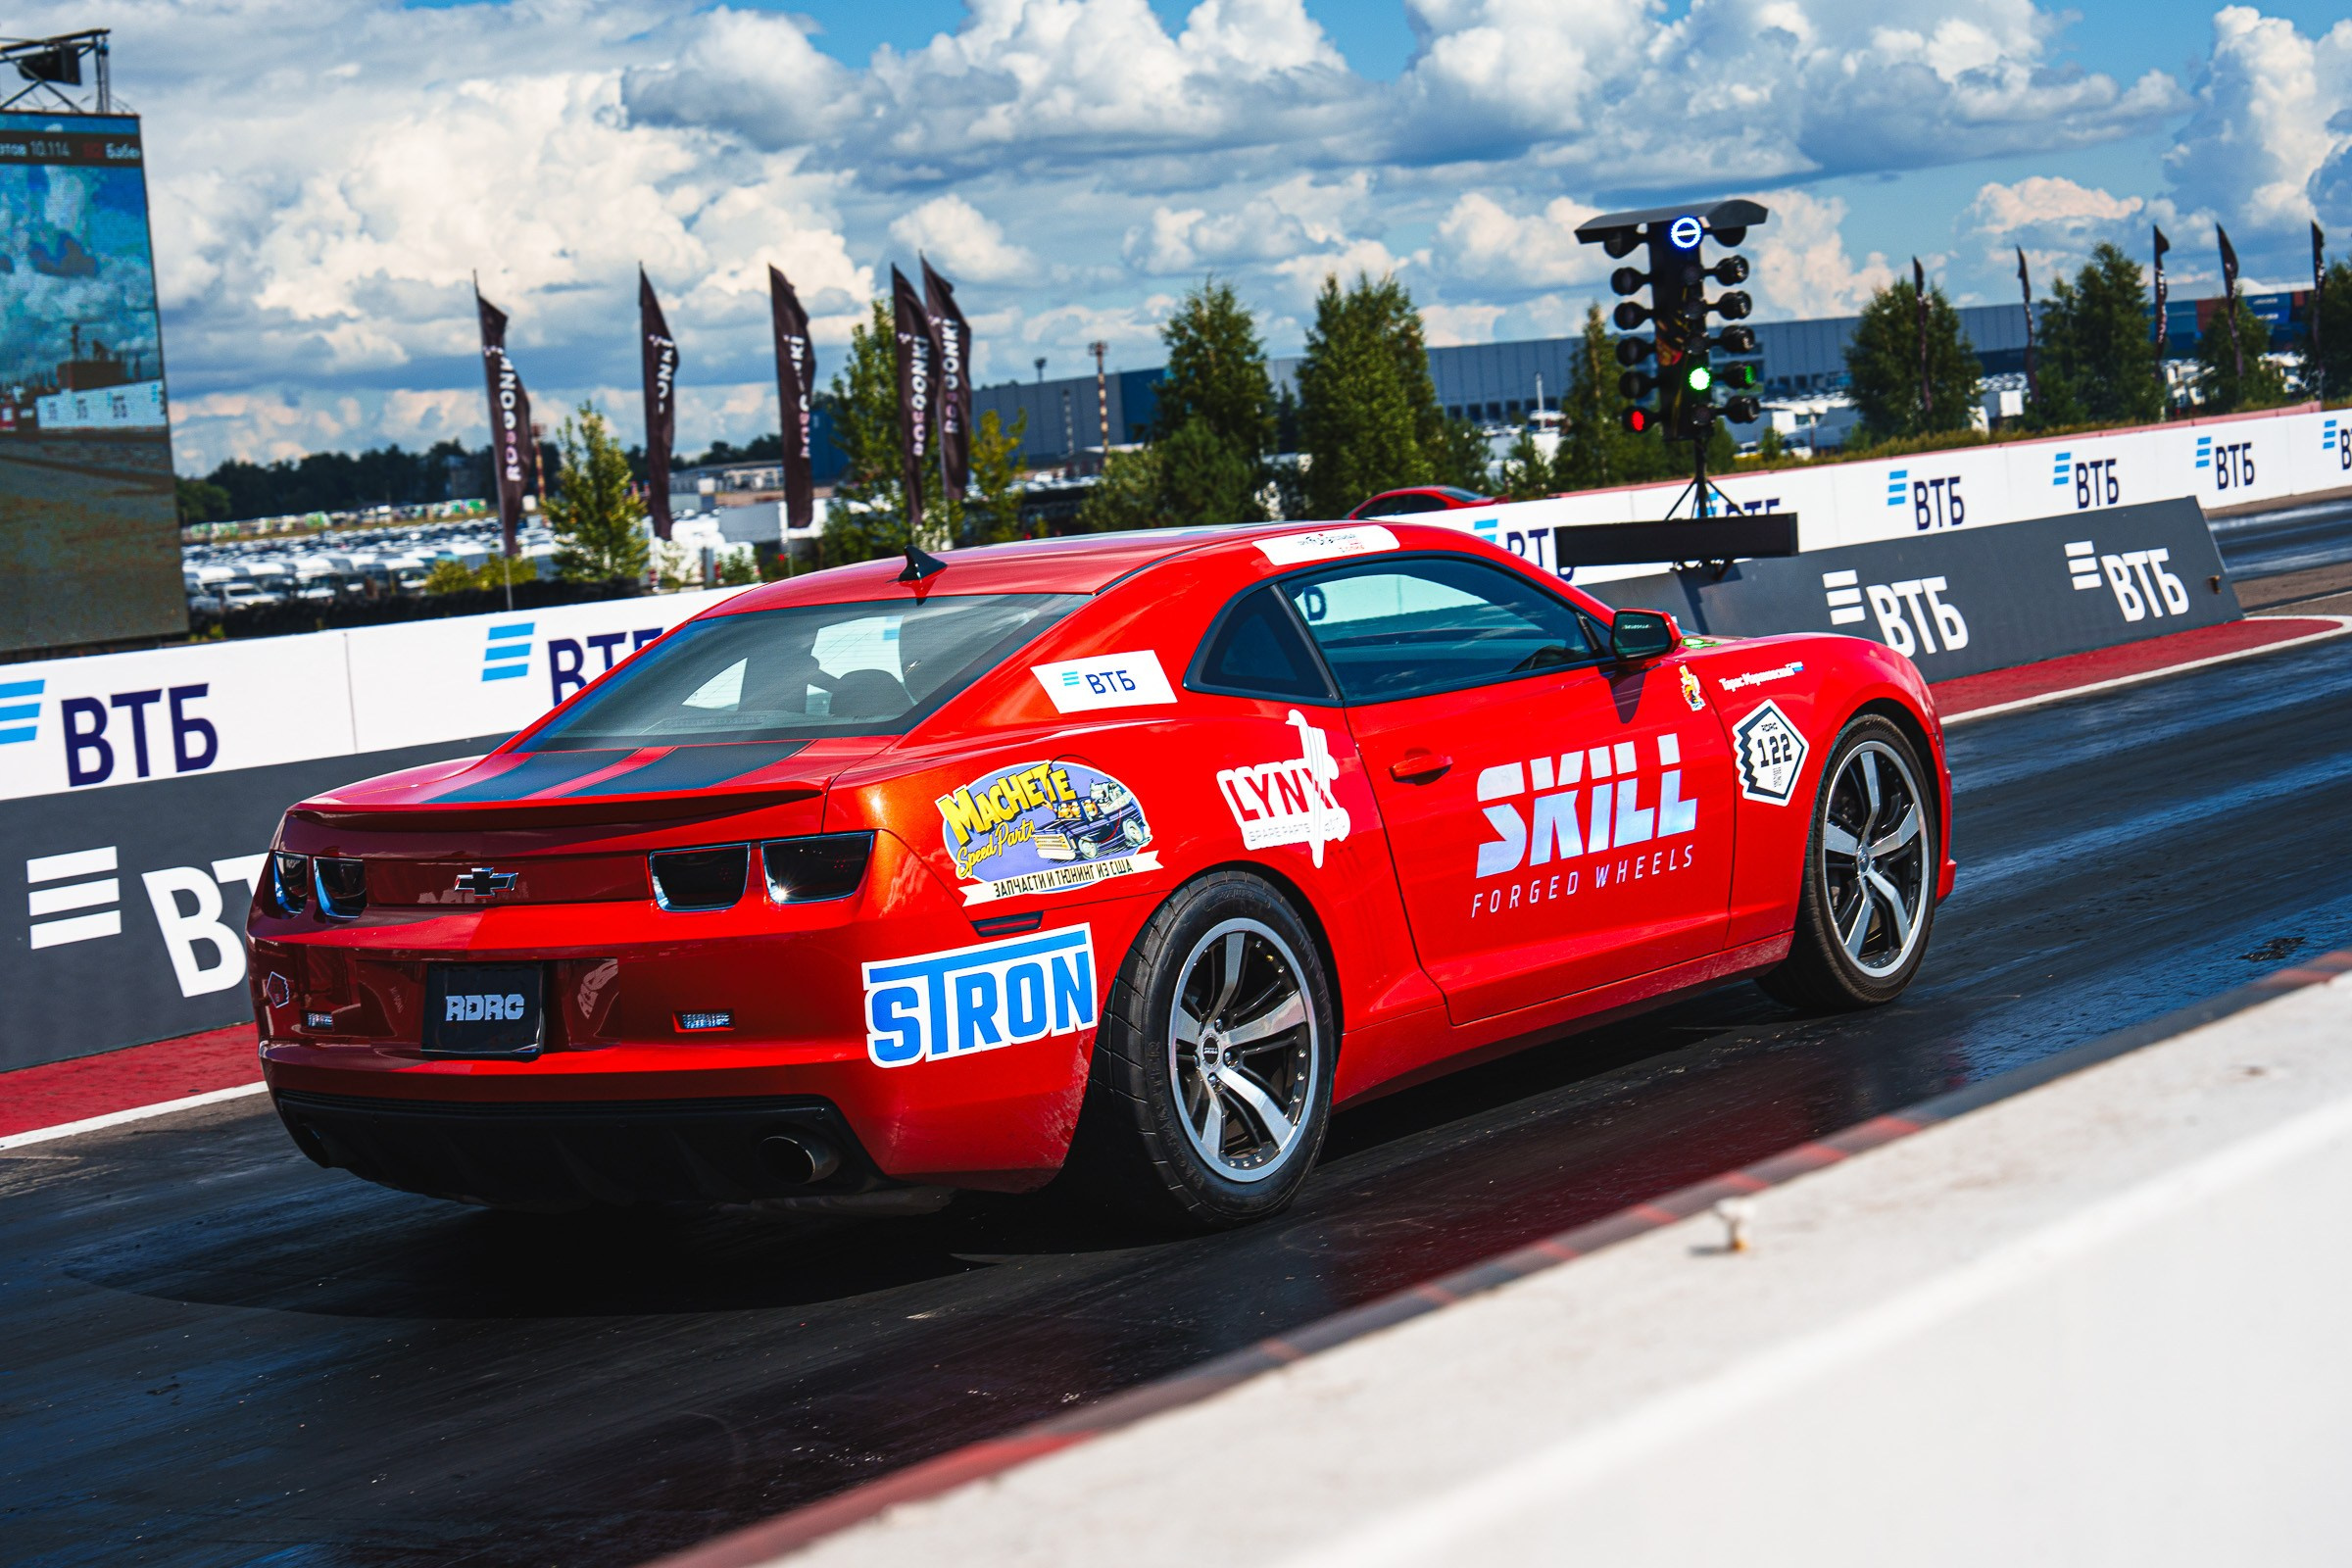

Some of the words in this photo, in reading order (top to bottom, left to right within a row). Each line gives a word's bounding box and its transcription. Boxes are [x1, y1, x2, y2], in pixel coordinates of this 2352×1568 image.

[2075, 458, 2120, 510] ВТБ
[2215, 441, 2255, 490] ВТБ
[1913, 475, 1965, 532] ВТБ
[2100, 547, 2189, 622] ВТБ
[1866, 575, 1969, 659] ВТБ
[1085, 669, 1136, 695] ВТБ
[61, 683, 219, 787] ВТБ
[1757, 733, 1792, 767] 122
[938, 762, 1077, 847] MACHETE
[1476, 732, 1697, 879] SKILL
[956, 834, 998, 877] Speed
[995, 818, 1035, 857] Parts
[994, 873, 1046, 898] ЗАПЧАСТИ
[1047, 873, 1054, 887] И
[1055, 864, 1095, 885] ТЮНИНГ
[1097, 862, 1109, 878] ИЗ
[1110, 858, 1134, 875] США
[1471, 870, 1579, 918] FORGED
[1594, 844, 1693, 889] WHEELS
[445, 994, 525, 1021] RDRC
[869, 929, 1097, 1063] STRON
